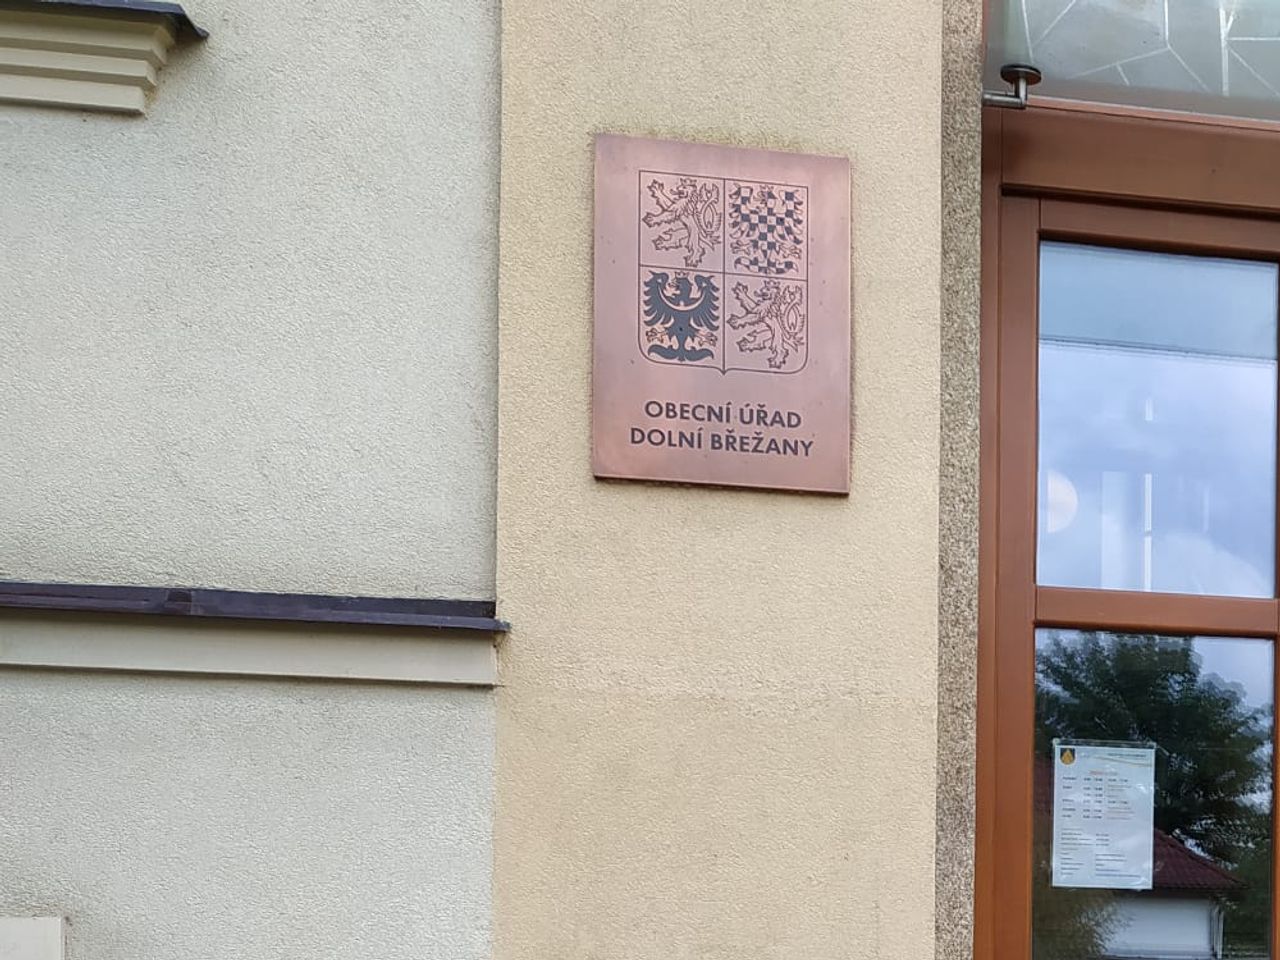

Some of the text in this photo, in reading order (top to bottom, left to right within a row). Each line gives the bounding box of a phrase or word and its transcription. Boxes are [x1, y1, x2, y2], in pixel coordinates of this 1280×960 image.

[644, 400, 802, 429] OBECNÍ ÚŘAD
[630, 427, 814, 457] DOLNÍ BŘEŽANY
